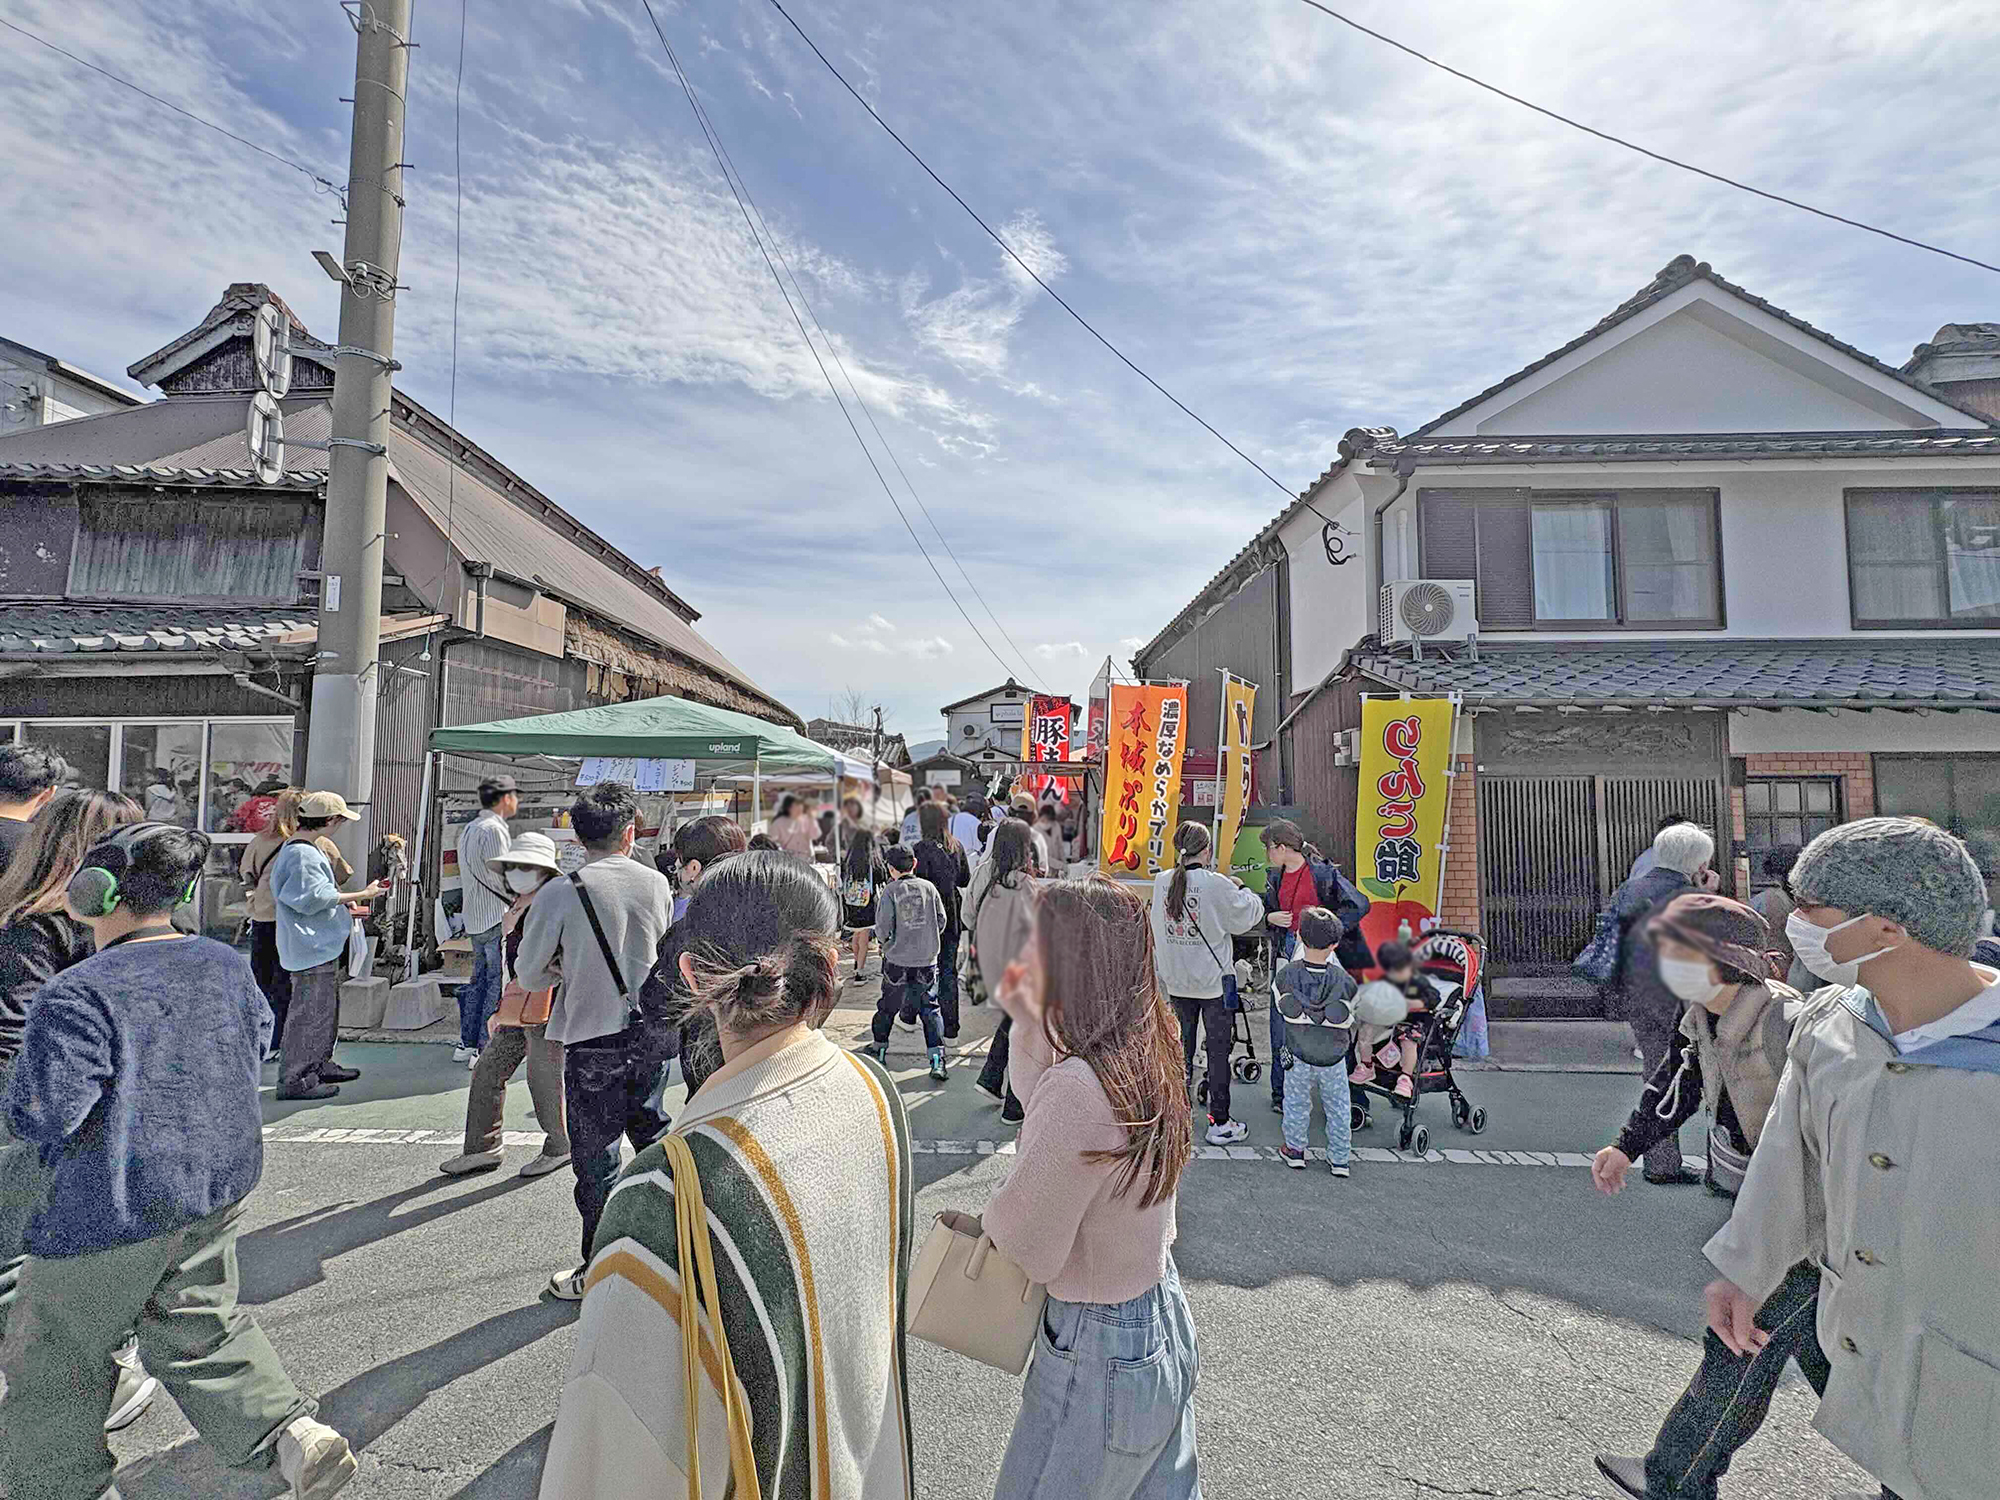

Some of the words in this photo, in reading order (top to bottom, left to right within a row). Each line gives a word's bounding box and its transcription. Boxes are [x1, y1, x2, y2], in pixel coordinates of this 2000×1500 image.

[709, 742, 741, 754] upland
[1147, 698, 1180, 877] 濃厚なめらかプリン
